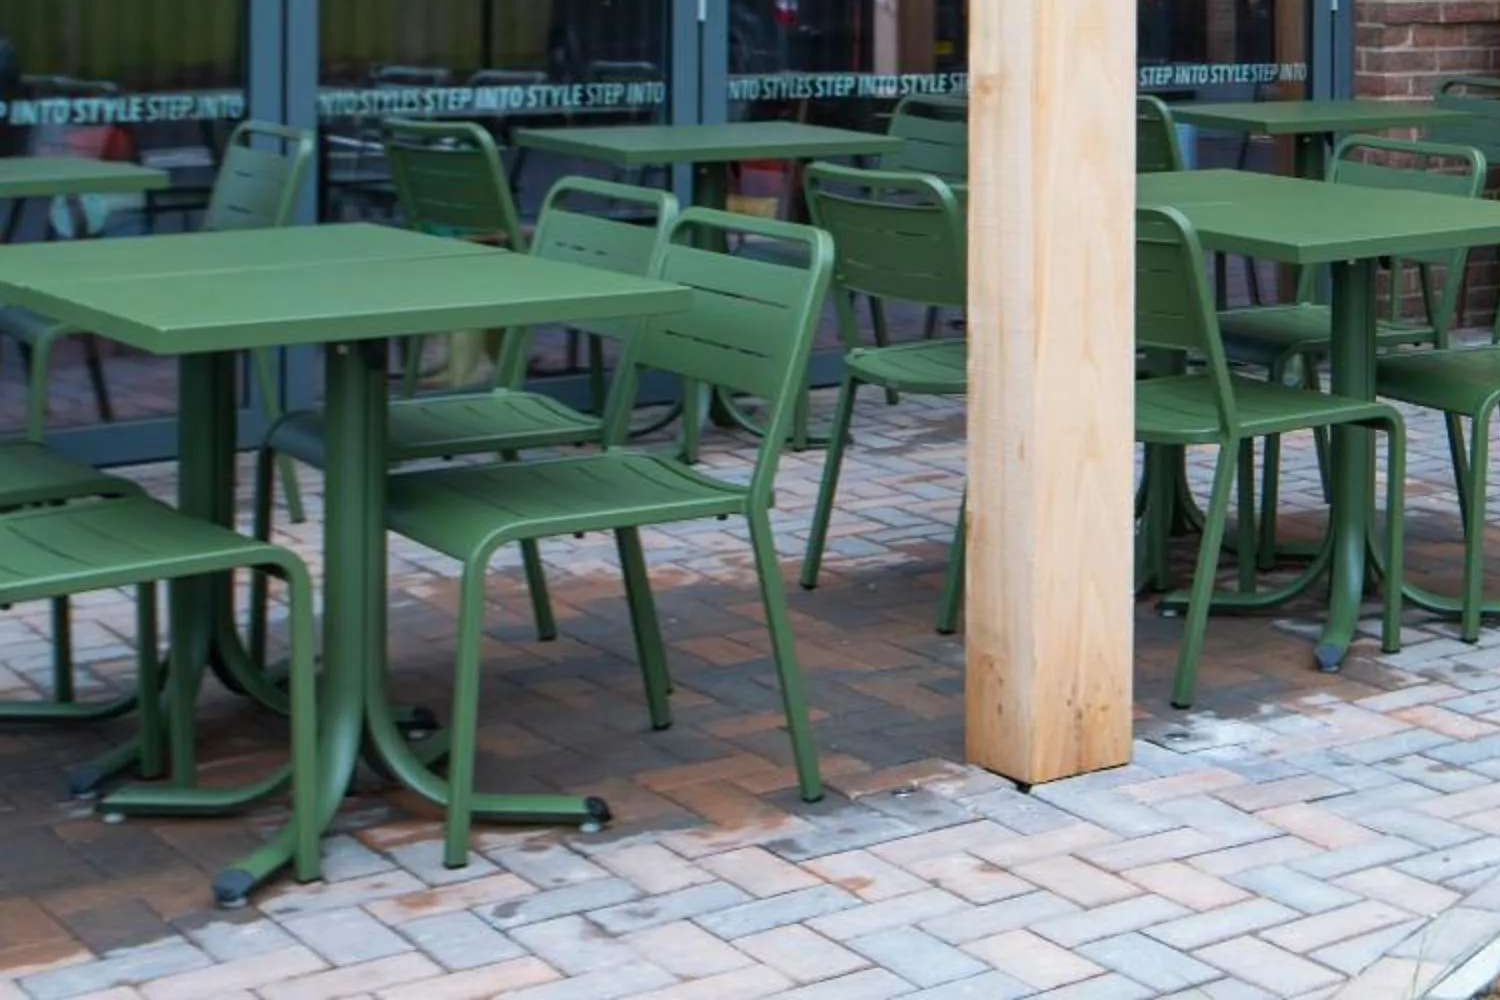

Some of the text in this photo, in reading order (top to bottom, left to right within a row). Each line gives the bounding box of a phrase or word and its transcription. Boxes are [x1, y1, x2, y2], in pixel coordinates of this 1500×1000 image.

[761, 76, 812, 100] STYLES
[814, 75, 854, 97] STEP
[857, 75, 897, 96] INTO
[899, 73, 948, 94] STYLE
[1139, 62, 1306, 86] STEP INTO STYLE STEP INTO
[10, 98, 69, 125] INTO
[71, 96, 142, 123] STYLE
[424, 87, 472, 111] STEP
[475, 86, 523, 109] INTO
[526, 84, 582, 108] STYLE
[585, 83, 625, 105] STEP
[626, 82, 666, 105] INTO
